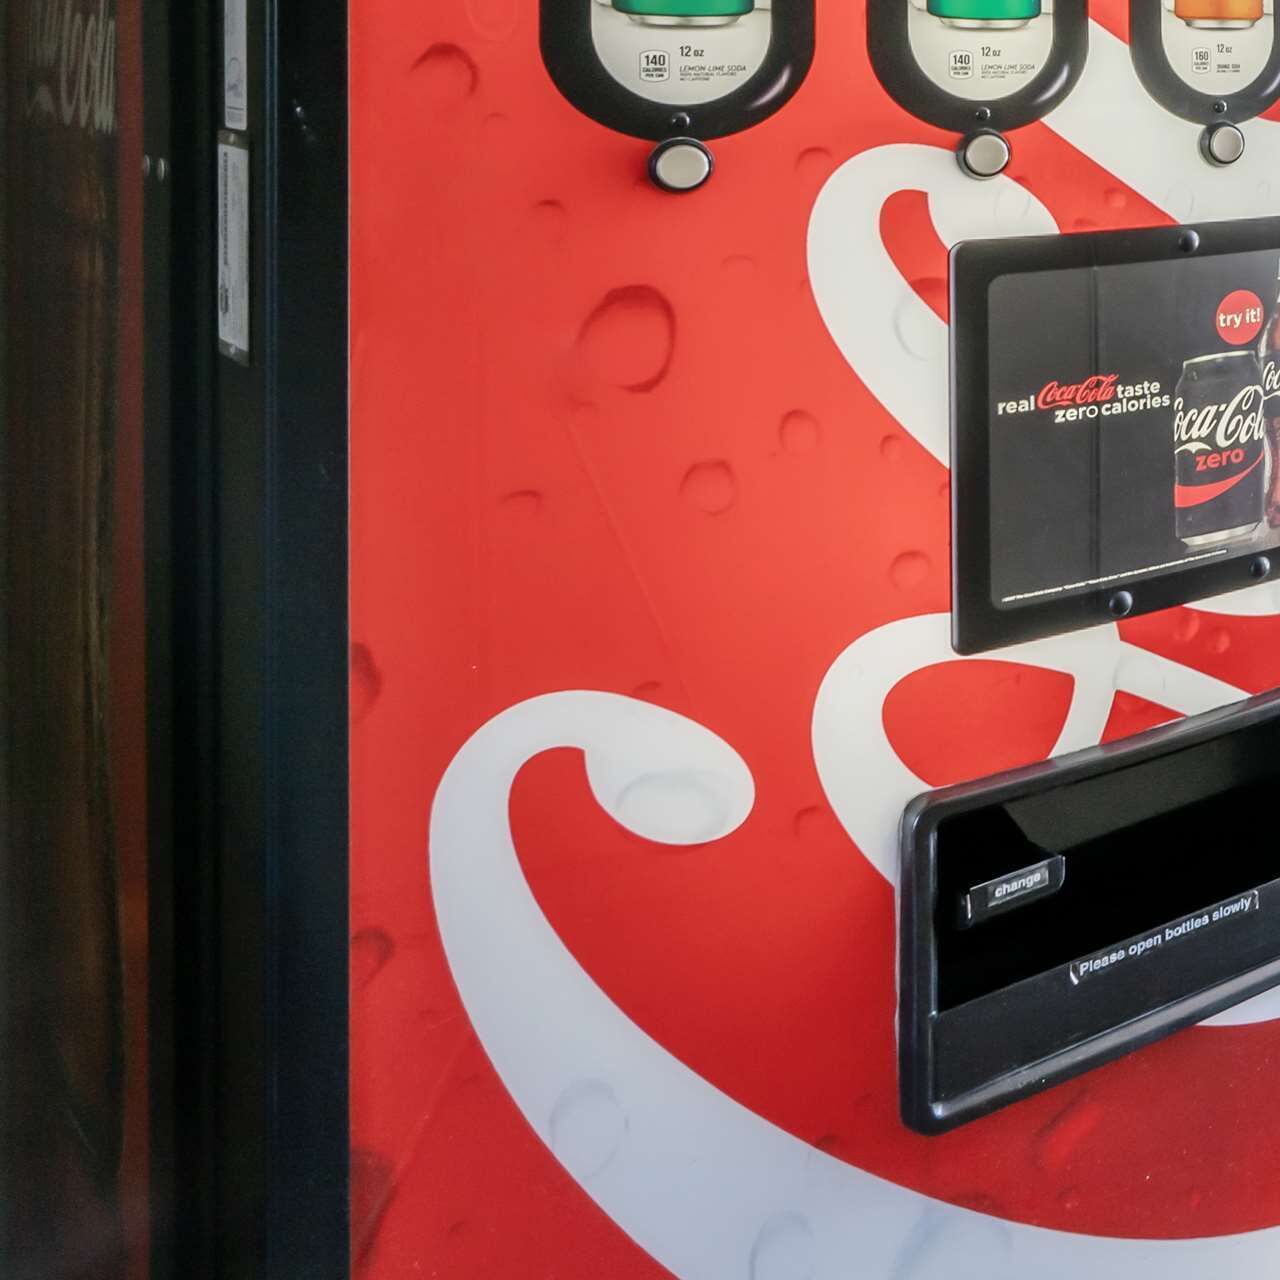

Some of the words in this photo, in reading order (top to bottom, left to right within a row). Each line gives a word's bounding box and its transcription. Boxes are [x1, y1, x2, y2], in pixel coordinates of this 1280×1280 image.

[644, 55, 666, 66] 140
[679, 46, 692, 57] 12
[693, 49, 704, 57] oz
[953, 54, 970, 65] 140
[981, 46, 991, 56] 12
[1218, 311, 1243, 328] try
[1245, 308, 1261, 323] it!
[997, 395, 1035, 415] real
[1037, 374, 1119, 409] Coca-Cola
[1117, 381, 1160, 399] taste
[1054, 405, 1098, 423] zero
[1101, 394, 1170, 415] calories
[1195, 448, 1245, 471] zero
[995, 873, 1041, 897] change
[1079, 949, 1126, 976] Please
[1128, 934, 1162, 956] open
[1165, 915, 1209, 941] bottles
[1212, 897, 1252, 921] slowly
